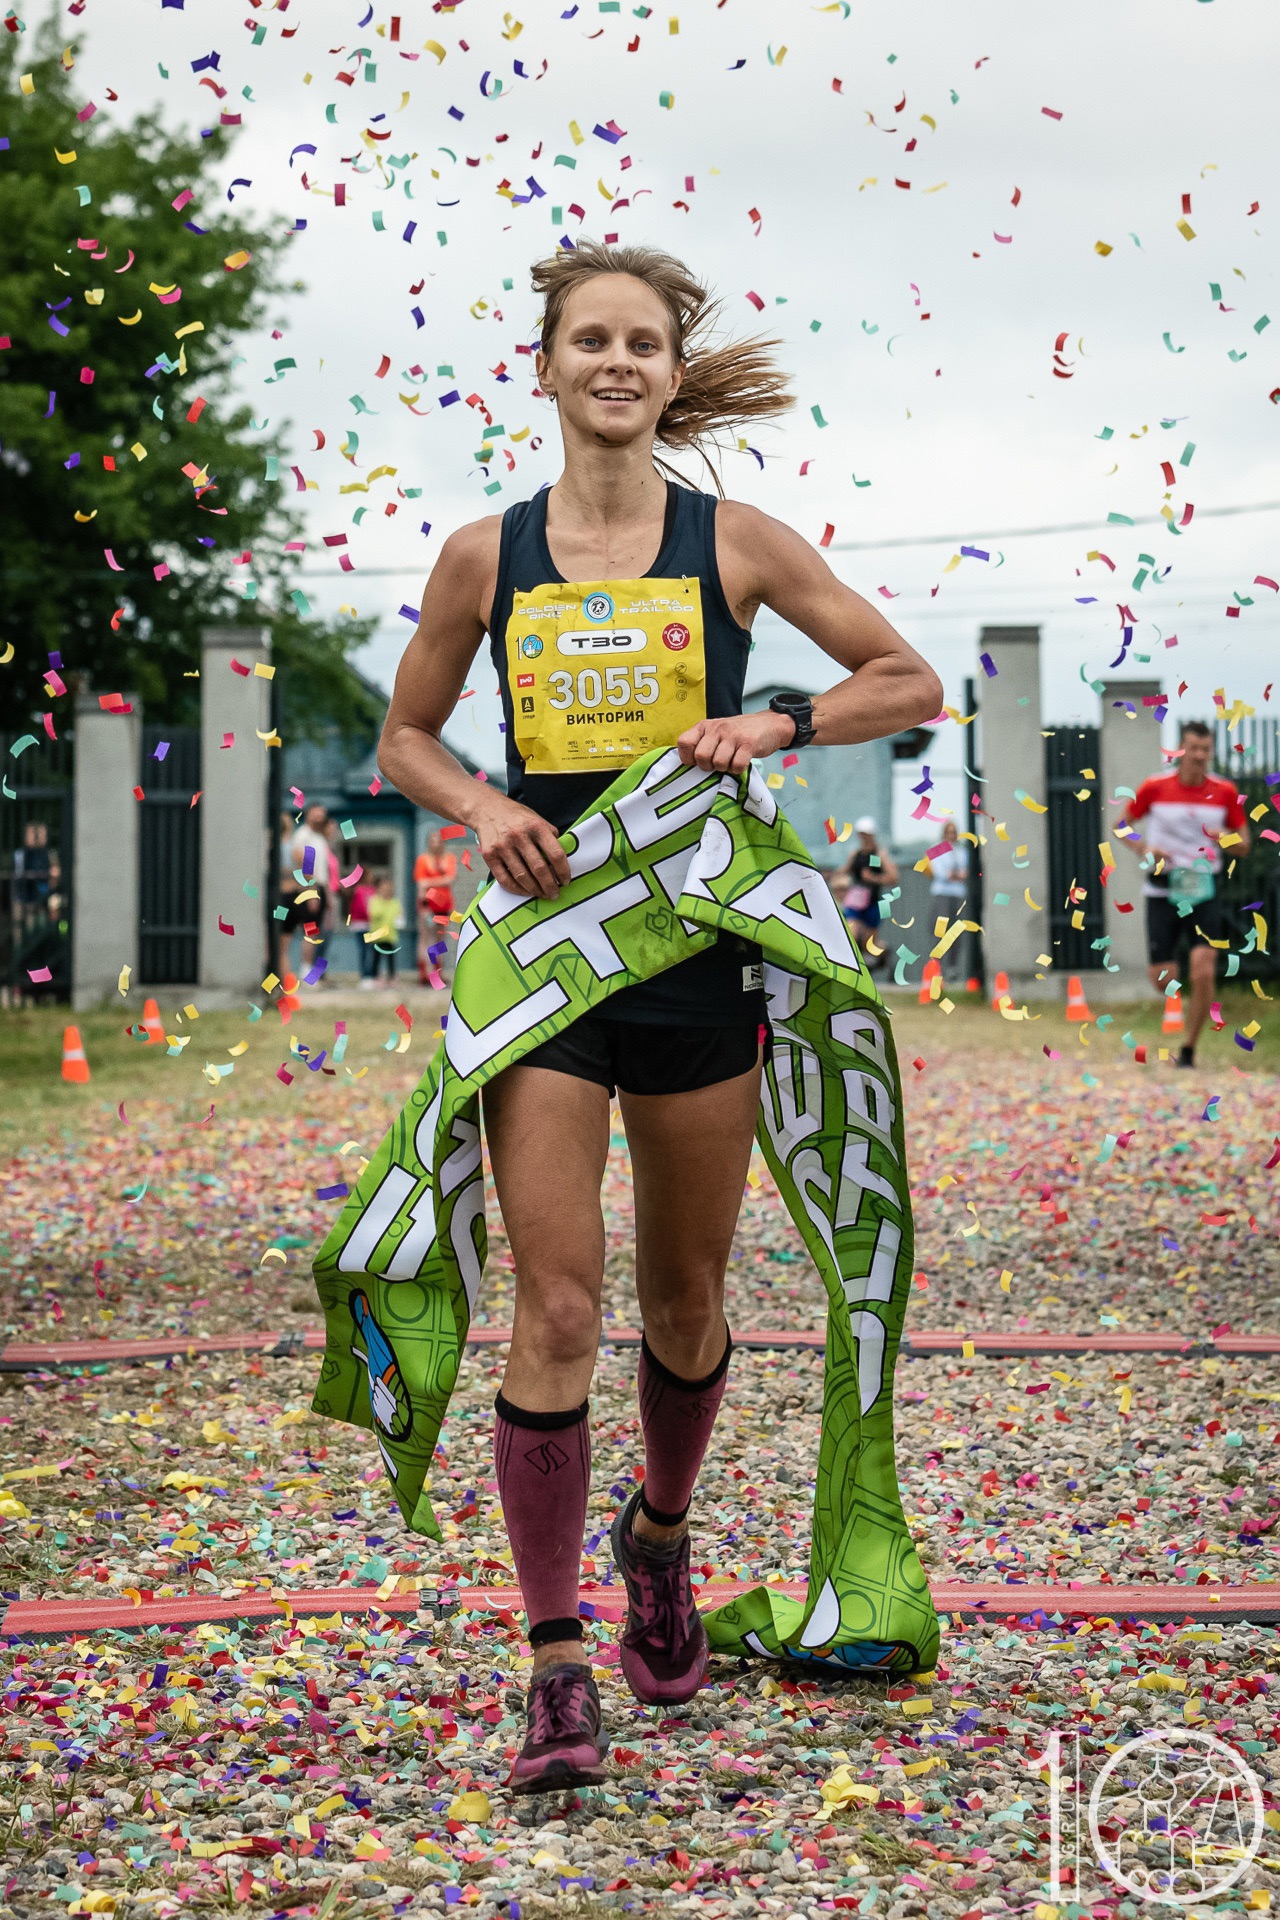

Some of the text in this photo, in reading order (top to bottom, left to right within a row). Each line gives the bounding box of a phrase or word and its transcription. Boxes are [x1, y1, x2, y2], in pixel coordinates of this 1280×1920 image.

[630, 598, 681, 607] ULTRA
[517, 604, 576, 614] GOLDEN
[619, 605, 695, 614] TRAIL 100
[529, 611, 562, 620] RING
[571, 635, 632, 648] T30
[547, 665, 660, 711] 3055
[566, 710, 645, 725] ВИКТОРИЯ
